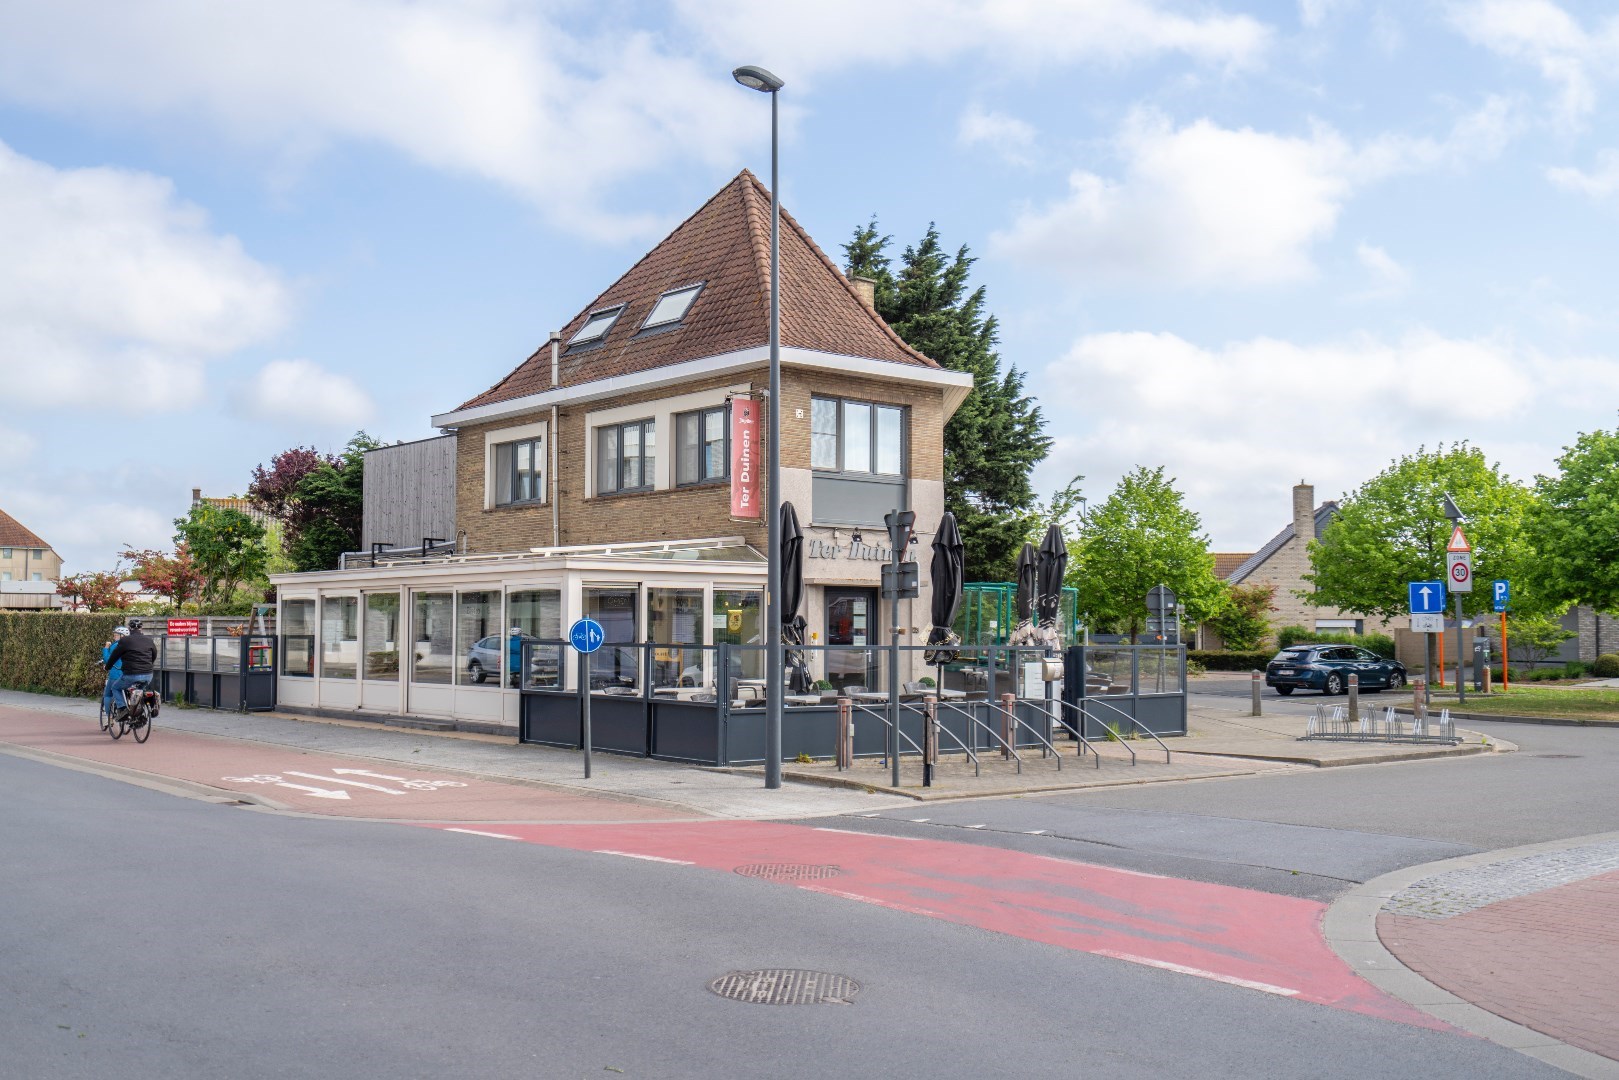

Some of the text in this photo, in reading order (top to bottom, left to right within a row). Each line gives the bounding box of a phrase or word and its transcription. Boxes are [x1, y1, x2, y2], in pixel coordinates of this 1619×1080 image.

[740, 430, 750, 482] Duinen
[740, 487, 750, 508] Ter
[809, 540, 917, 562] Ter Duinn
[1455, 568, 1465, 577] 30
[1495, 582, 1506, 600] P
